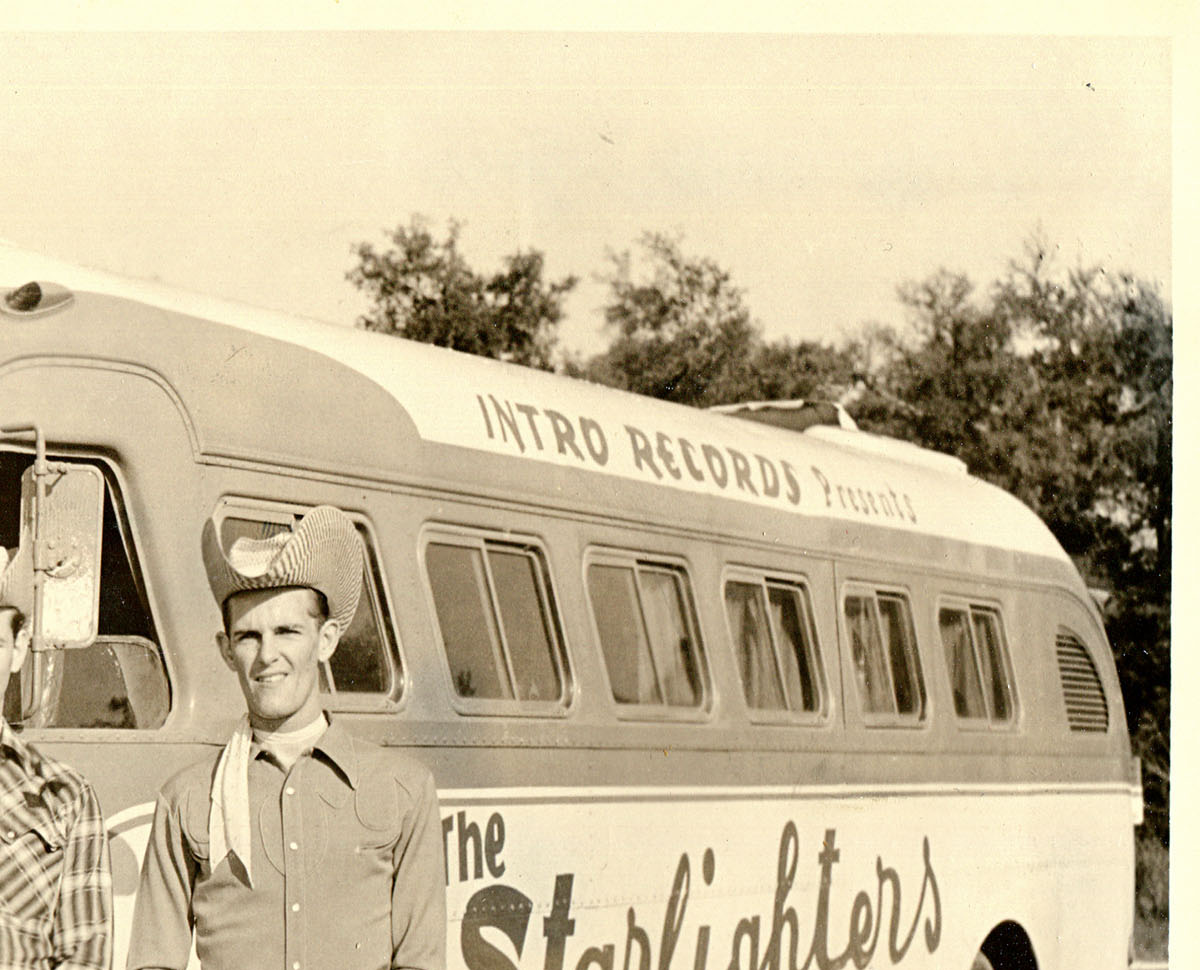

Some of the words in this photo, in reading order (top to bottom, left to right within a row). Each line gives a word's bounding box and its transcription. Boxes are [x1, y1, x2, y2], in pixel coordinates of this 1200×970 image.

[475, 394, 609, 466] INTRO
[622, 424, 801, 506] RECORDS
[809, 465, 917, 524] Presents
